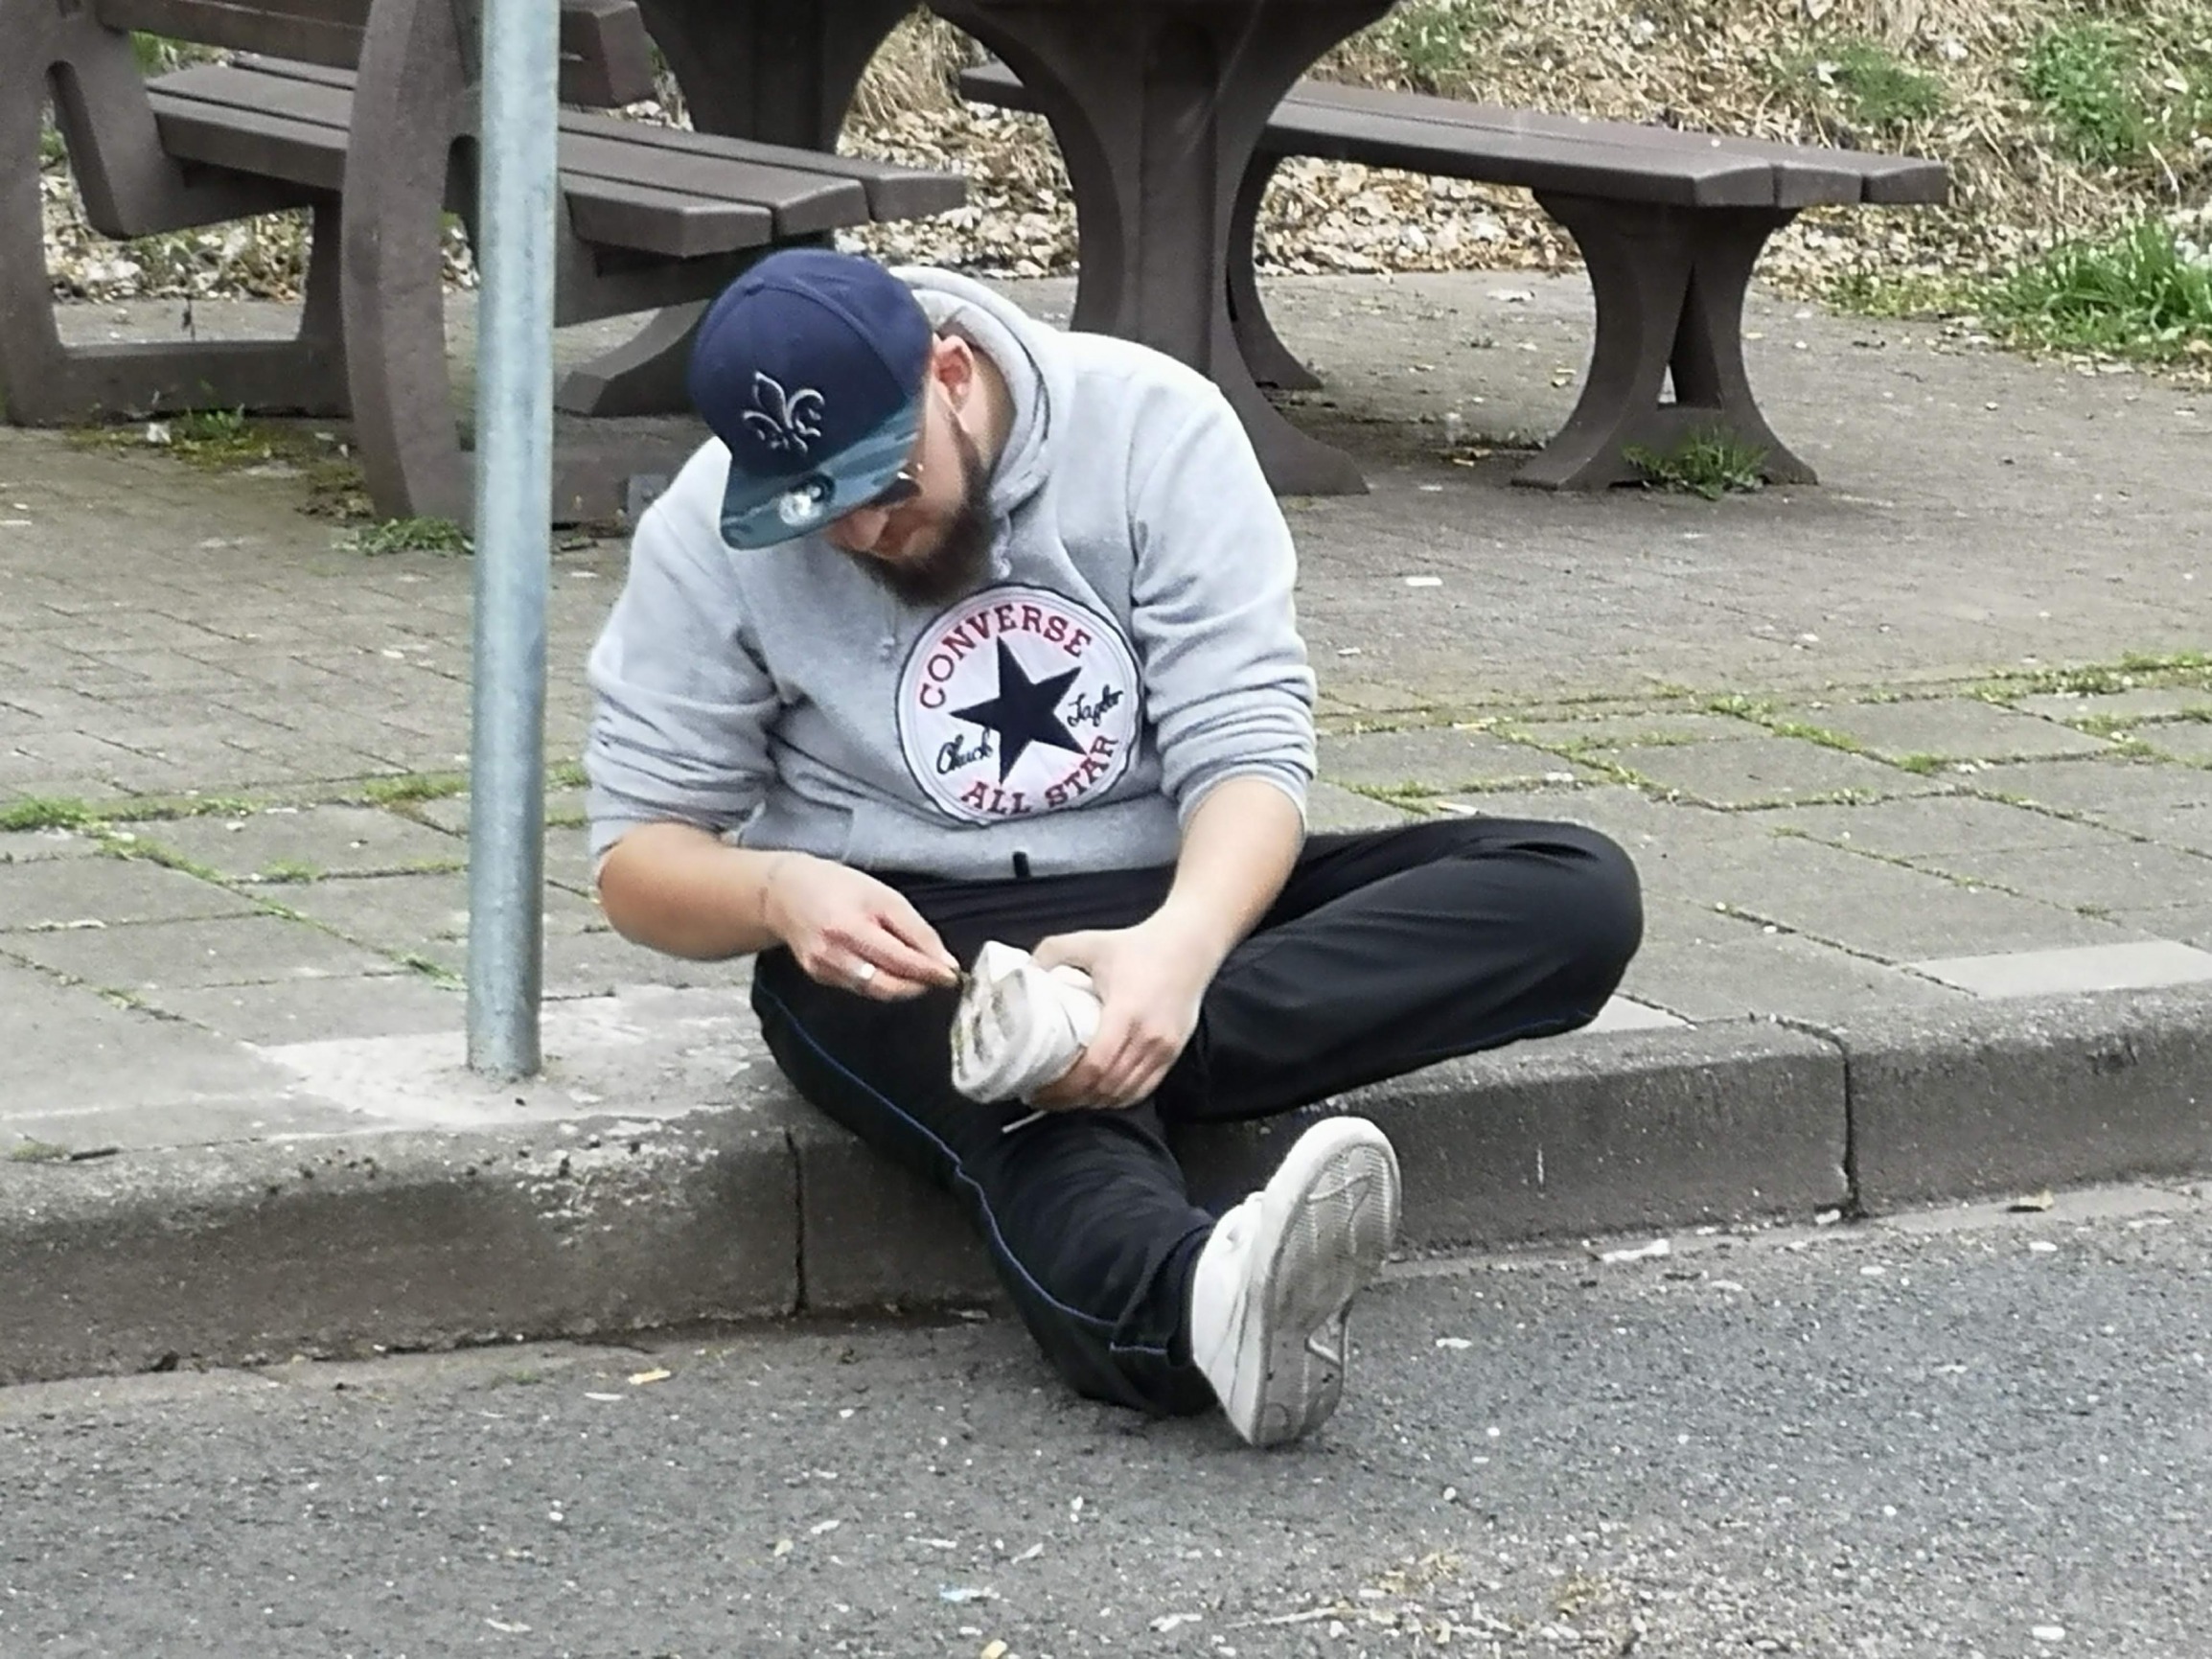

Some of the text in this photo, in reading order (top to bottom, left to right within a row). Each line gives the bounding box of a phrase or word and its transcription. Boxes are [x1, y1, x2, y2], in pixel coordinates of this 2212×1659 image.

[919, 604, 1092, 709] CONVERSE
[961, 735, 1118, 815] ALL STAR
